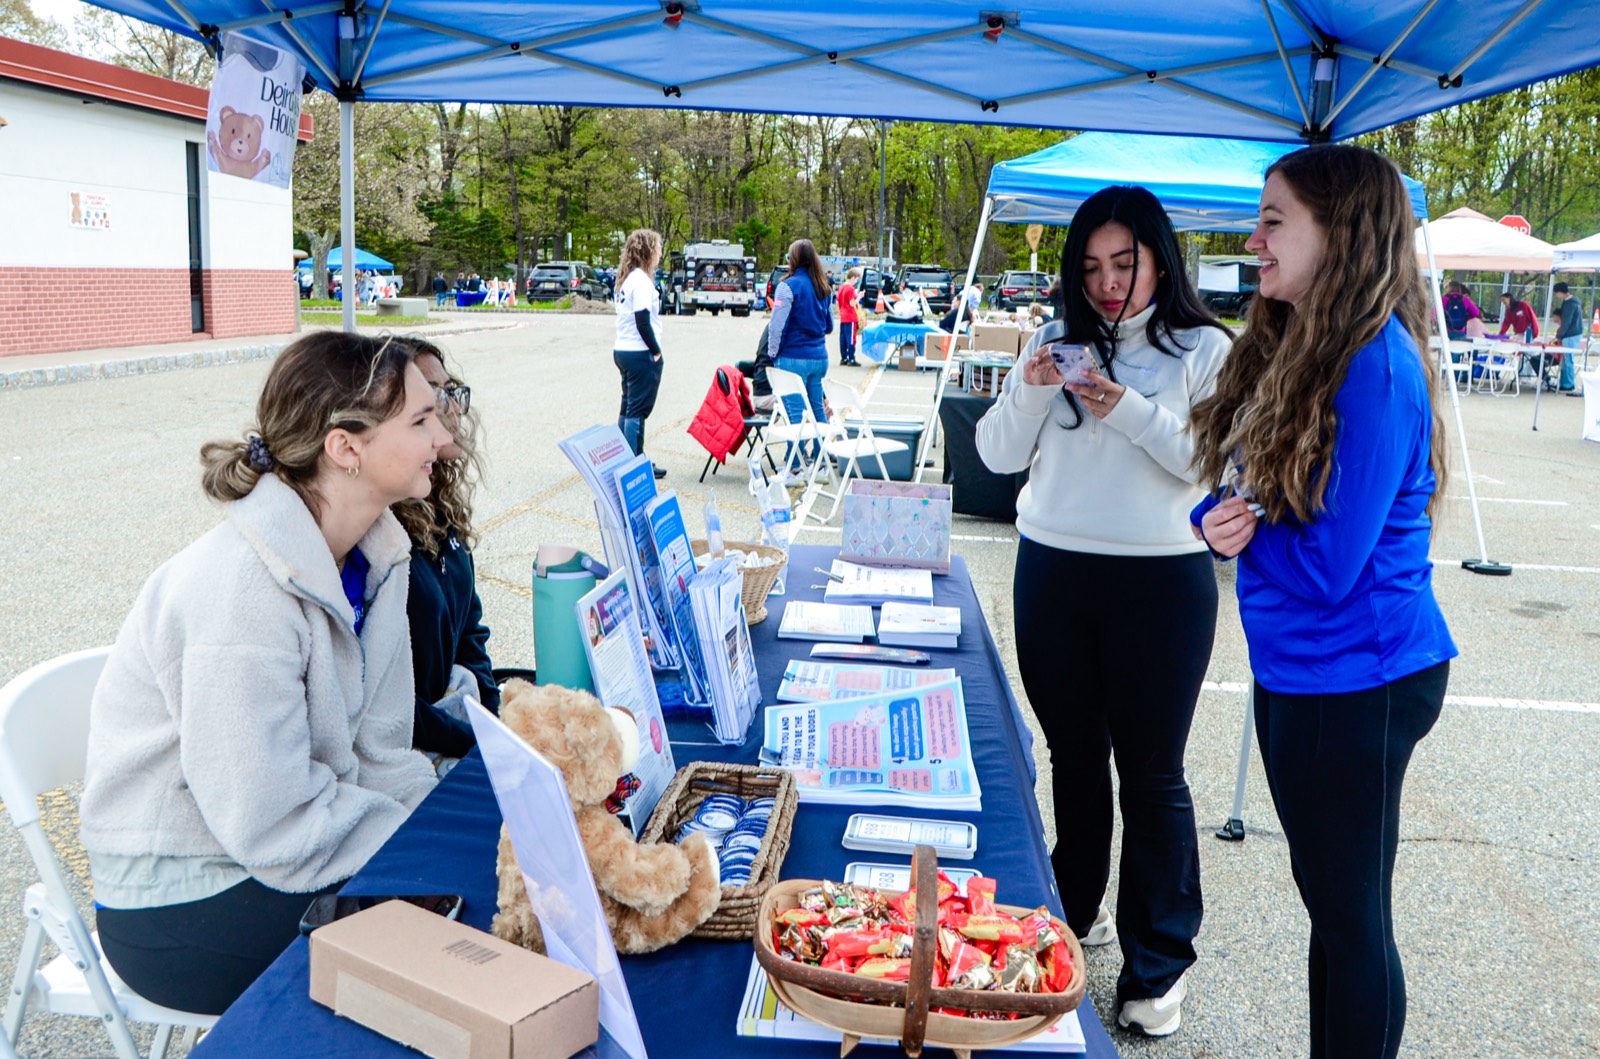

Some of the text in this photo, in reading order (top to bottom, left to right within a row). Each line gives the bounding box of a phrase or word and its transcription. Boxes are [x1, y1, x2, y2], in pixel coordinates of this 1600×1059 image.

[807, 709, 815, 733] BODIES
[795, 730, 802, 738] BE
[807, 734, 815, 750] YOUR
[864, 822, 879, 836] 988
[878, 872, 895, 888] 988
